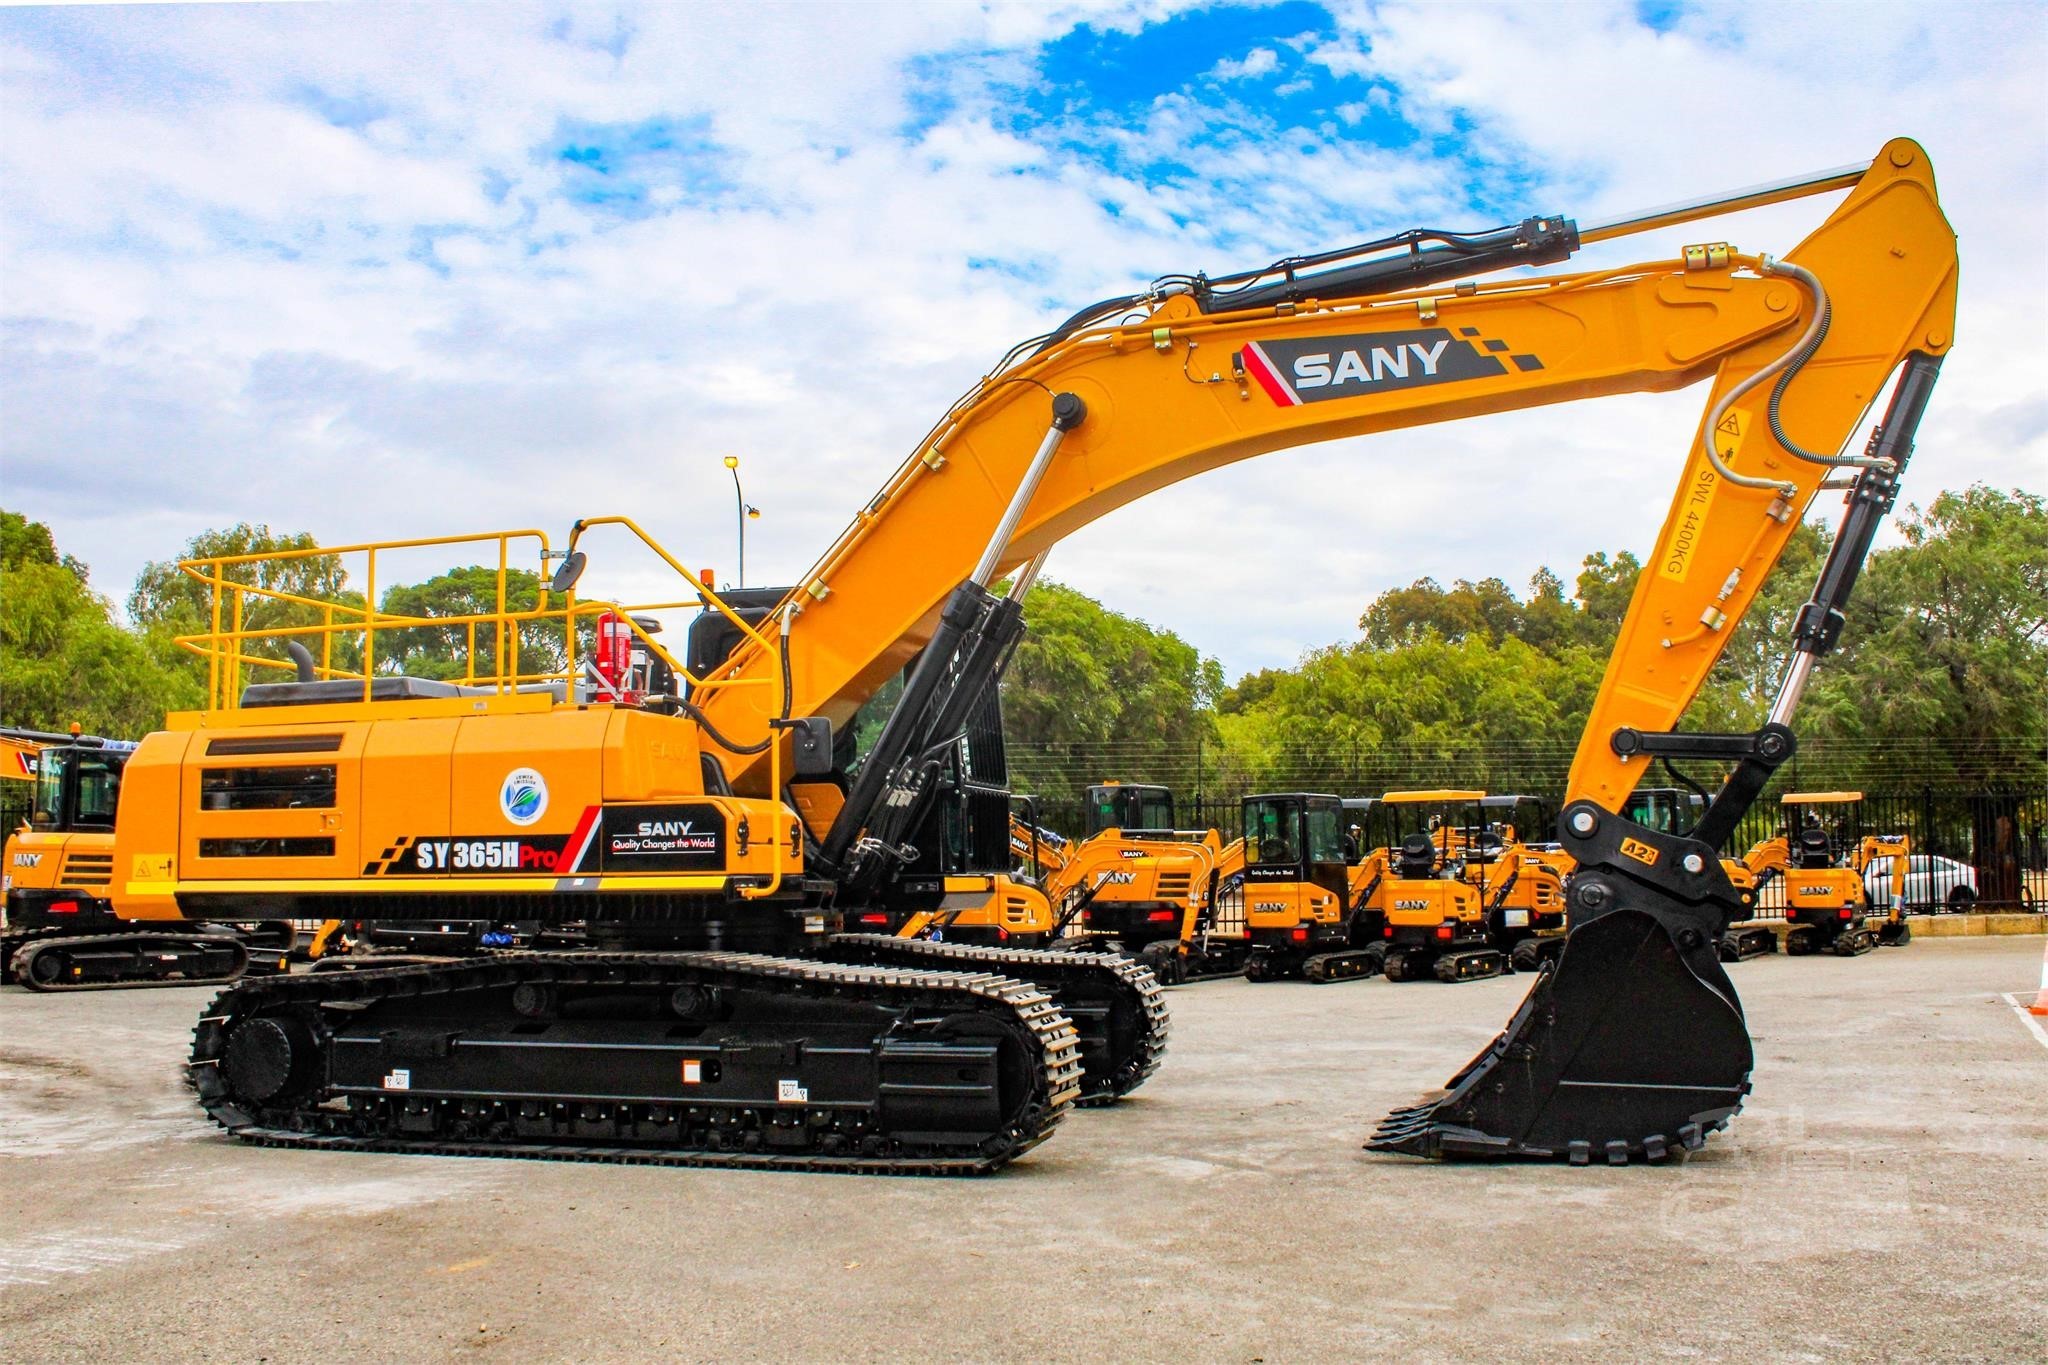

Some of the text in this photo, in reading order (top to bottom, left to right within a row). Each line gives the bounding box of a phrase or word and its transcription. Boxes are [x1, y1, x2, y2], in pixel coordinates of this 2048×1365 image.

[1293, 340, 1450, 390] SANY
[1667, 470, 1715, 574] SWL 4400KG
[638, 821, 693, 836] SANY
[612, 837, 716, 851] Quality Changes the World
[1012, 837, 1029, 851] SANY
[1799, 885, 1834, 896] SANY
[1253, 902, 1288, 912] SANY
[1394, 899, 1431, 911] SANY
